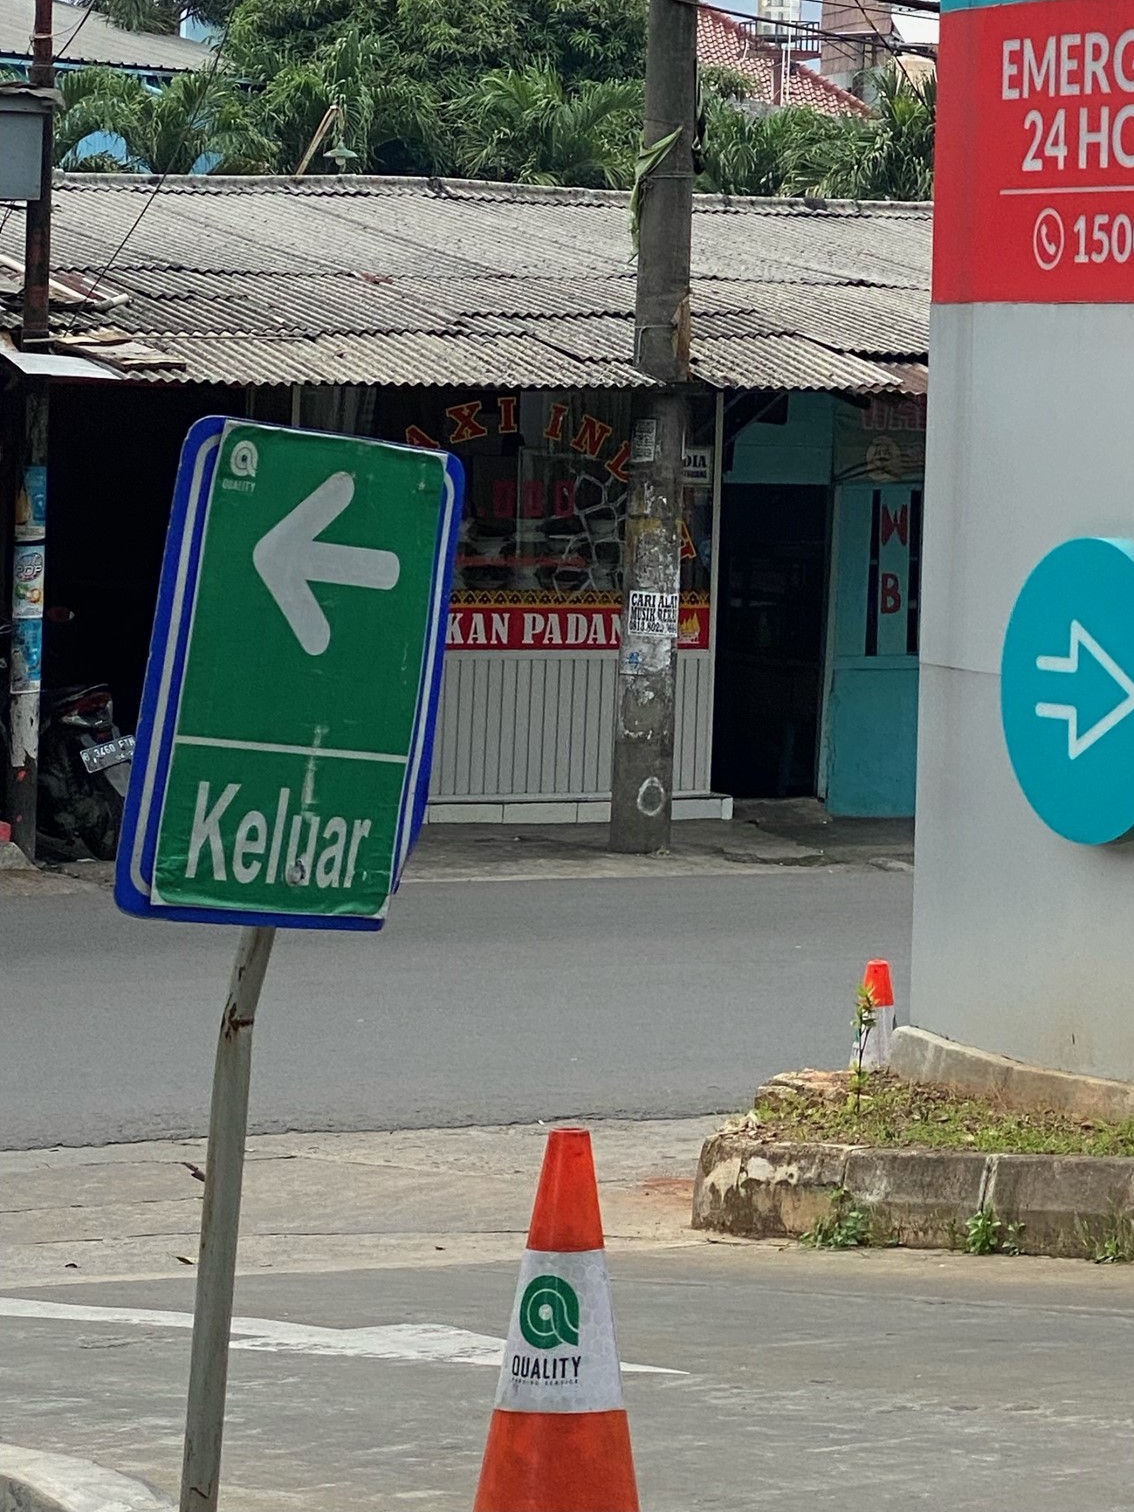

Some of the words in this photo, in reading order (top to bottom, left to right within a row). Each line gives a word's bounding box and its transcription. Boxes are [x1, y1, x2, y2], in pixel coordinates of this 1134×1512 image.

[1021, 108, 1068, 172] 24
[631, 593, 657, 607] CARI
[631, 606, 656, 622] MUSIK
[445, 613, 511, 644] KAN
[521, 613, 622, 644] PADAN
[184, 780, 372, 888] Keluar
[511, 1355, 581, 1379] QUALITY
